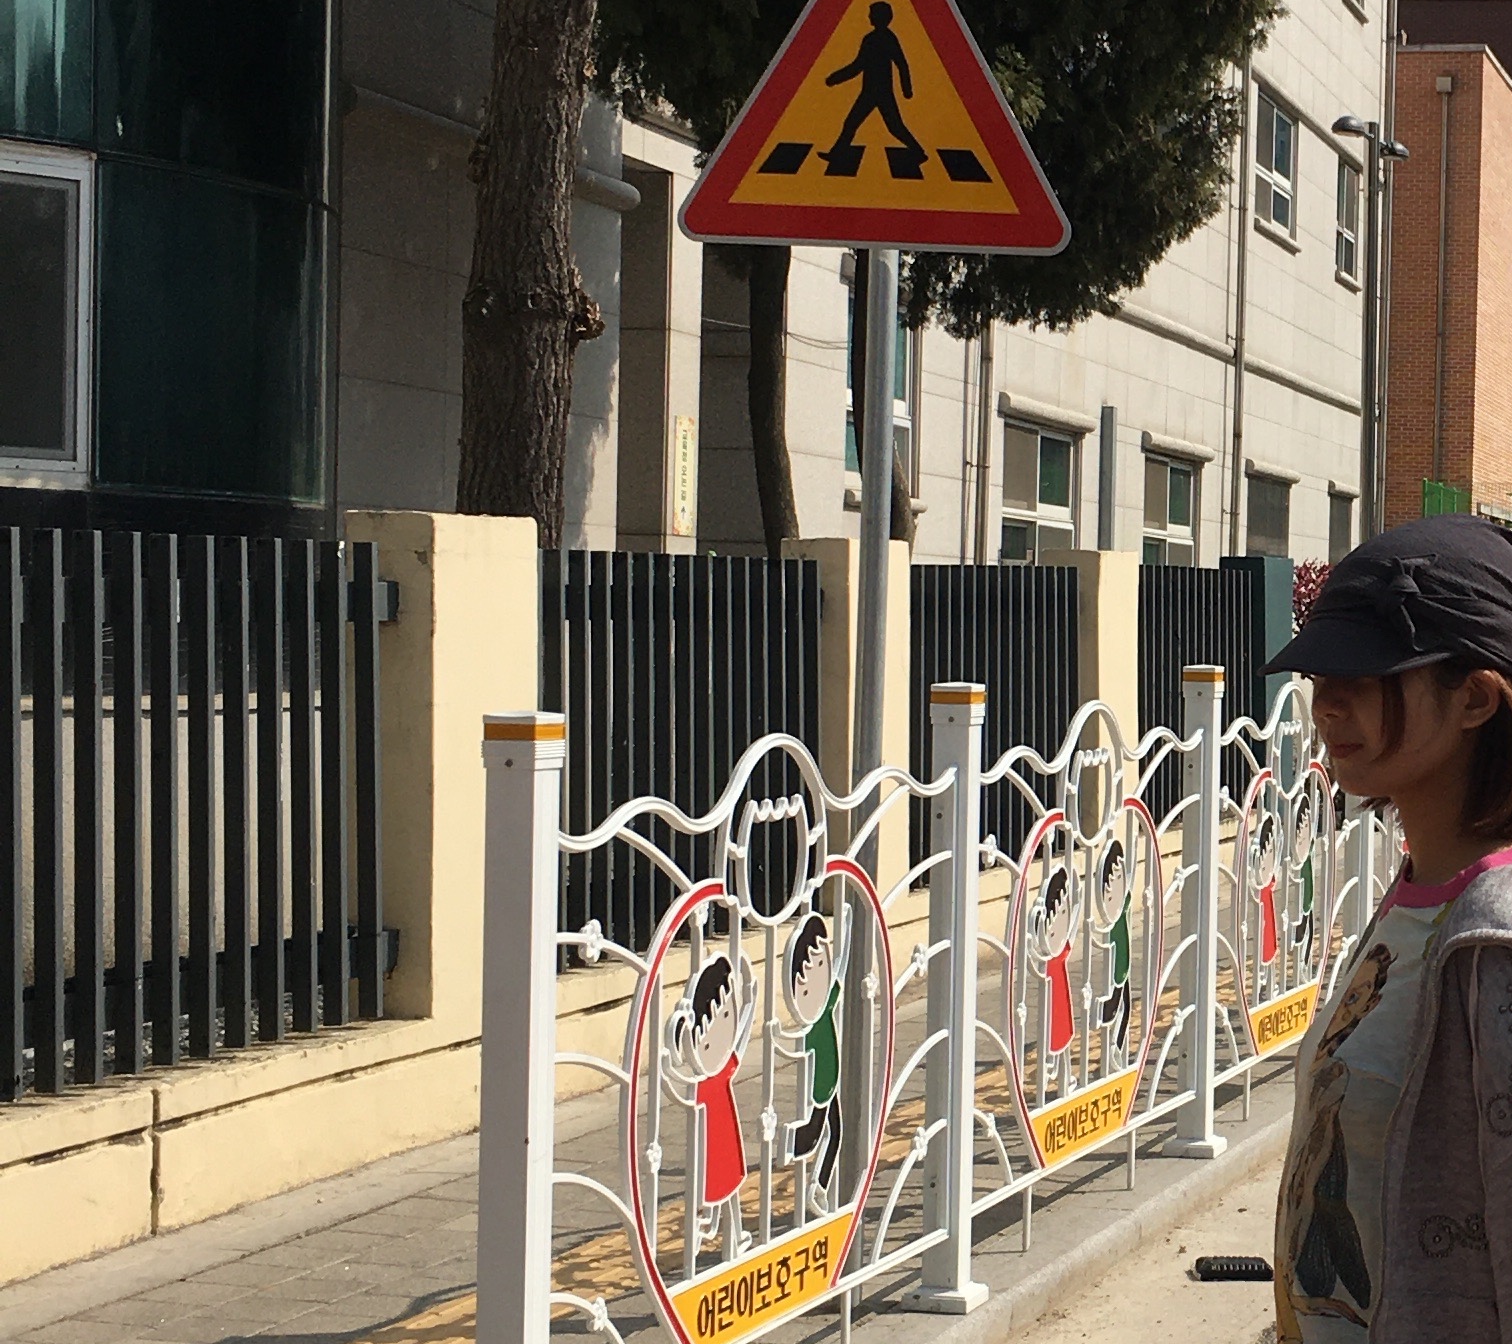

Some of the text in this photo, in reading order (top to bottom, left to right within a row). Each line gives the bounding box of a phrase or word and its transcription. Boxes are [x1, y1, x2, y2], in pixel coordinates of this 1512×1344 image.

[1258, 996, 1308, 1045] 어린이보호구역
[1044, 1087, 1122, 1154] 어린이보호구역
[697, 1235, 829, 1339] 어린이보호구역
